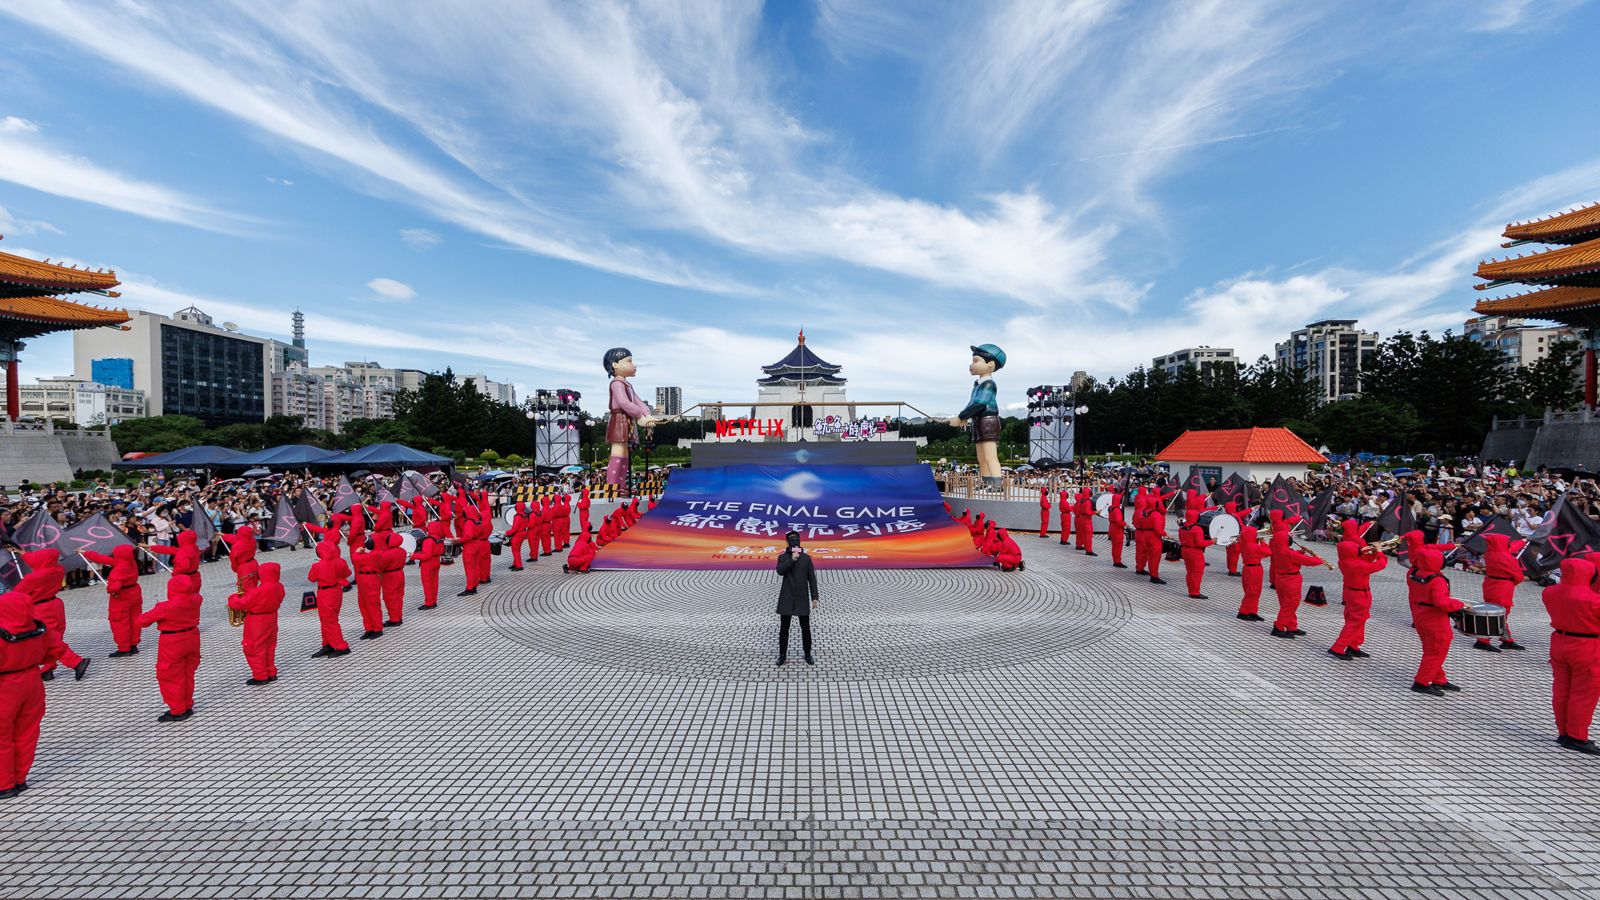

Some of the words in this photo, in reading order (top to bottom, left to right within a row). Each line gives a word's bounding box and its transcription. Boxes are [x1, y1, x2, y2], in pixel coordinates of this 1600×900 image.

[715, 418, 784, 438] NETFLIX
[686, 501, 742, 512] THE
[748, 503, 829, 518] FINAL
[836, 506, 916, 519] GAME
